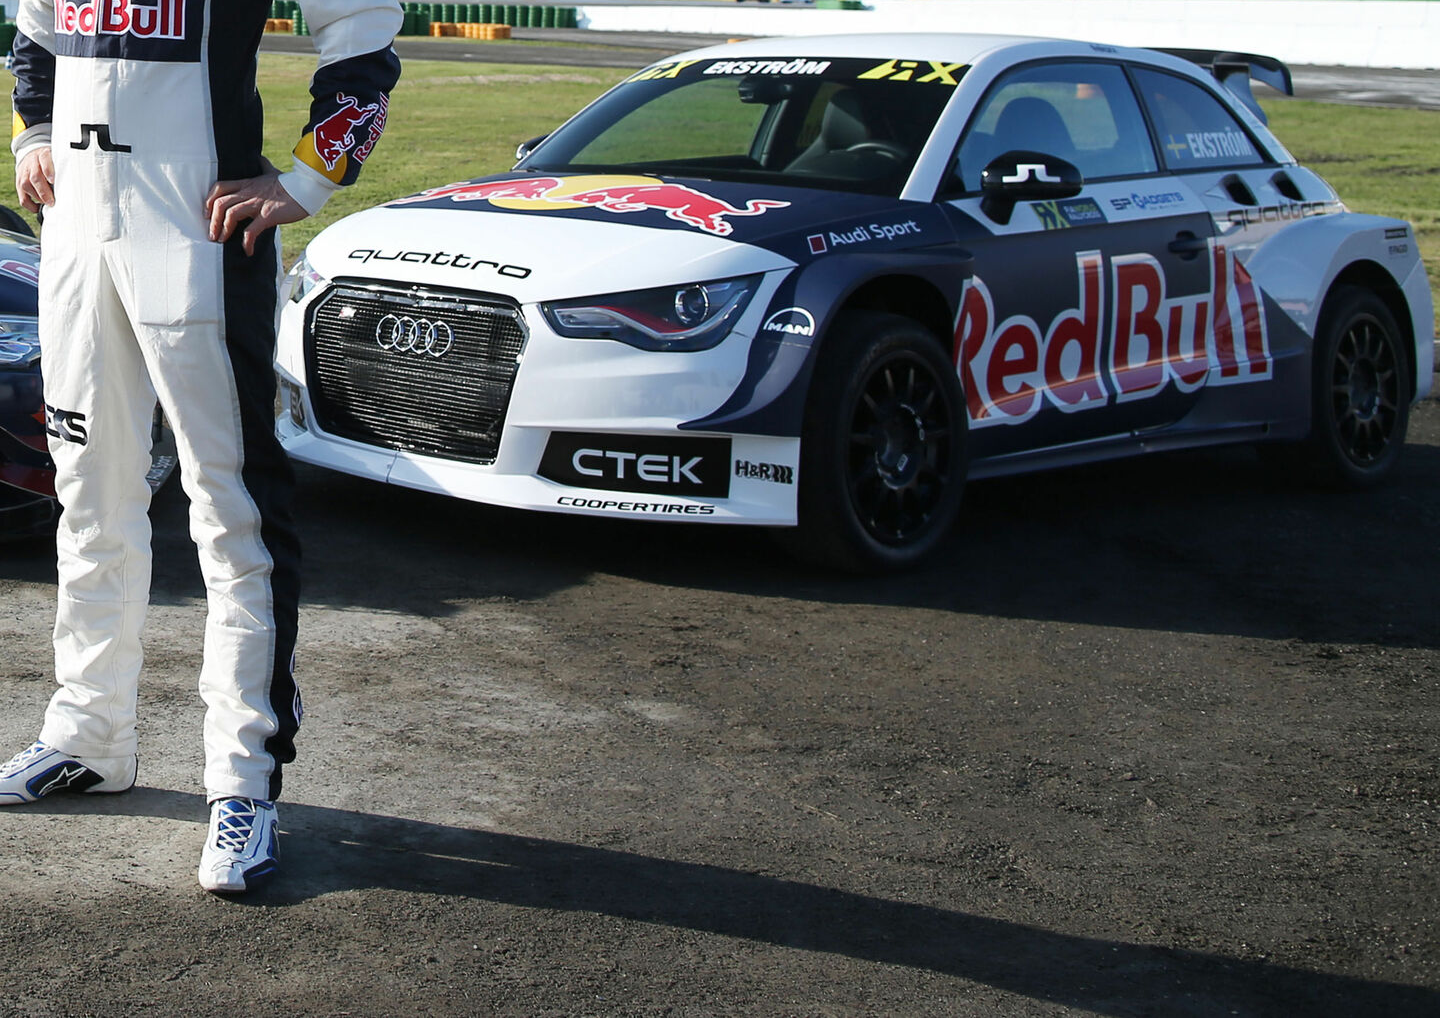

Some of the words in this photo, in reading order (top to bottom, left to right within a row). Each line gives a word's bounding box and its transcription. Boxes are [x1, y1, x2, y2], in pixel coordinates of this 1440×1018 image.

[703, 57, 832, 75] EKSTRÖM
[353, 125, 383, 164] Red
[374, 92, 389, 131] Bull
[1186, 126, 1252, 159] EKSTRÖM
[829, 226, 871, 246] Audi
[869, 220, 921, 240] Sport
[348, 249, 532, 279] quattro
[768, 322, 810, 336] MAN
[953, 249, 1108, 430] Red
[1109, 237, 1273, 404] Bull
[44, 403, 89, 446] EKS
[572, 448, 704, 484] CTEK
